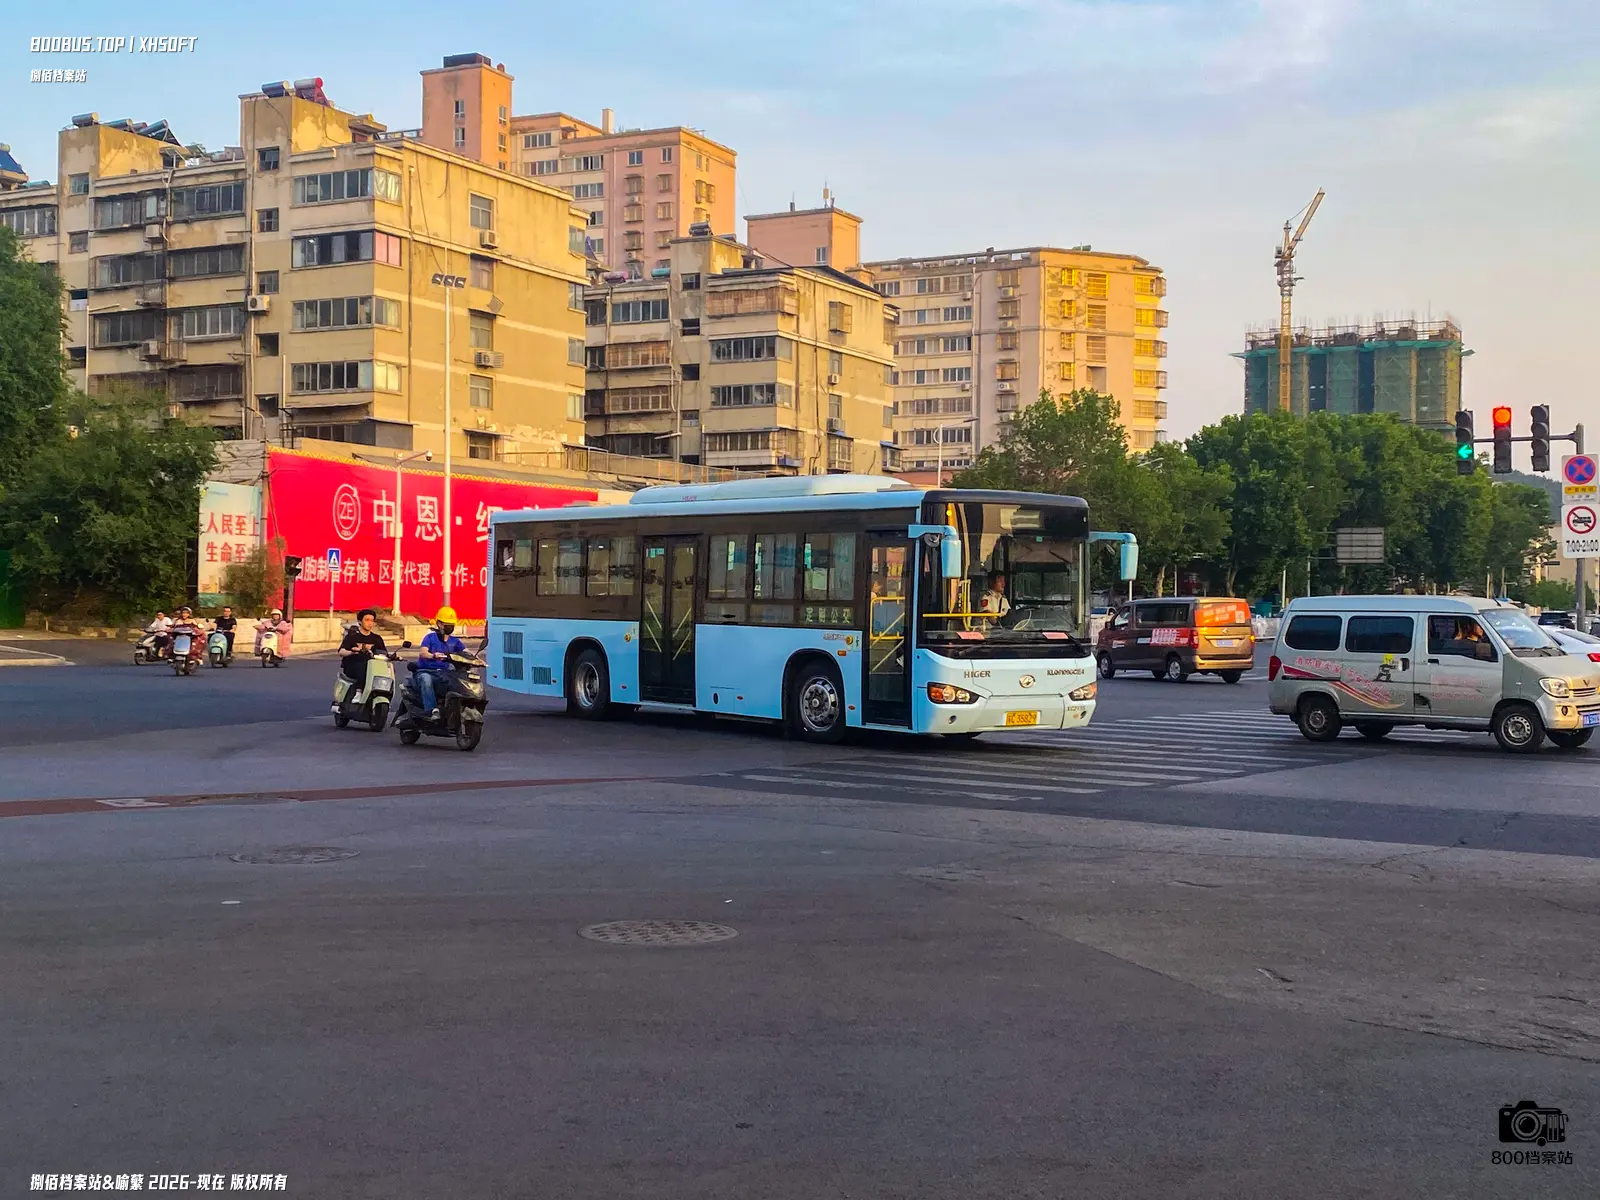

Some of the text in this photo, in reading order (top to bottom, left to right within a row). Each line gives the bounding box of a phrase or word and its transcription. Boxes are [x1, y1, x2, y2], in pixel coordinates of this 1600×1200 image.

[206, 511, 260, 536] 人民至上
[963, 670, 991, 679] HIGER
